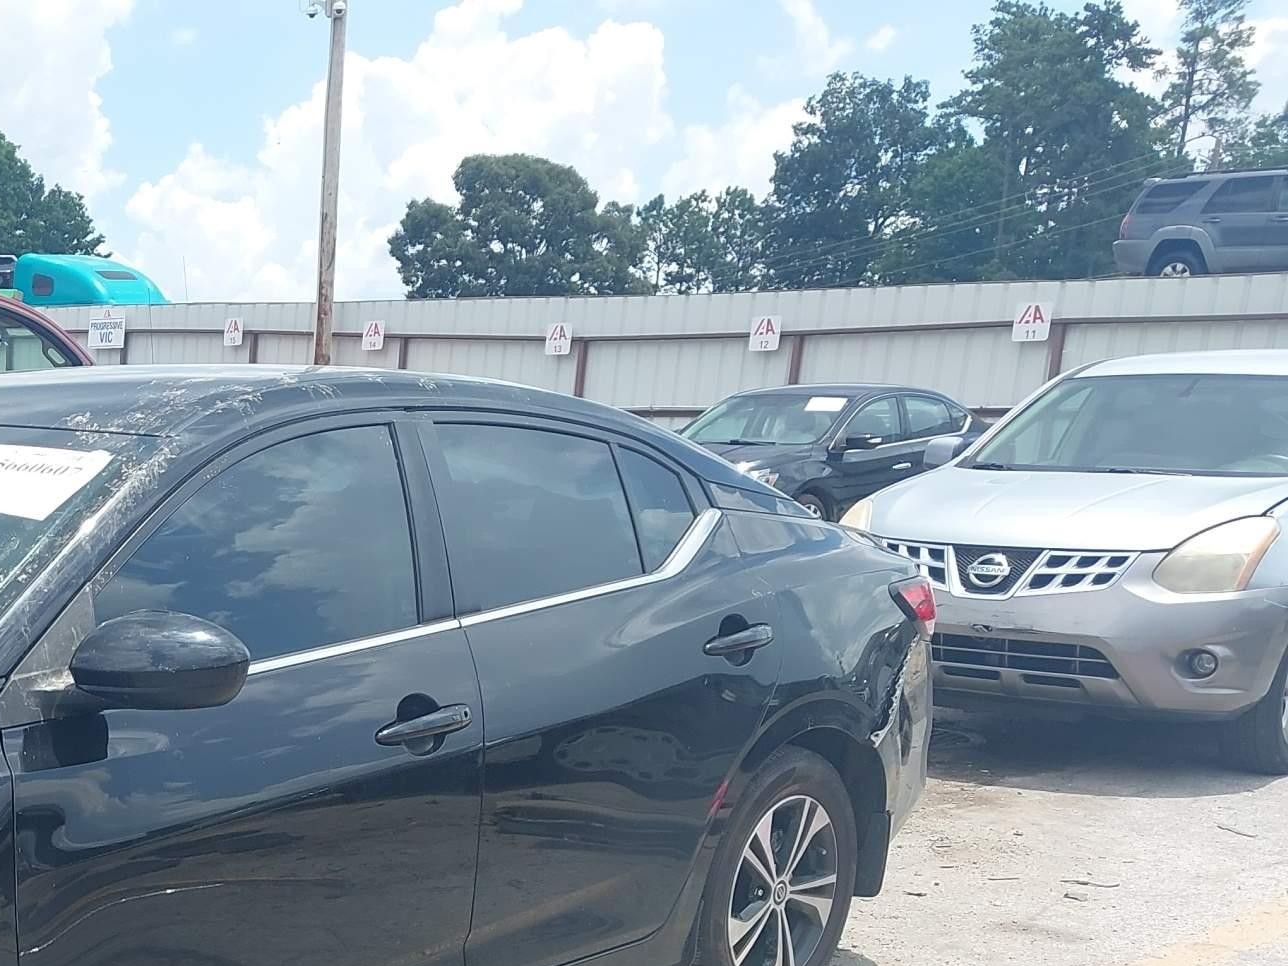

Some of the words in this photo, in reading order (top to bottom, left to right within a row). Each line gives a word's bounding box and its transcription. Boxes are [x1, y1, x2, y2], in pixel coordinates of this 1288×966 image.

[90, 321, 124, 330] PROGRESSIVE
[99, 331, 113, 344] VIC
[1024, 329, 1036, 340] 11
[369, 341, 377, 349] 14
[553, 344, 562, 353] 13
[760, 340, 769, 349] 12
[968, 565, 1007, 574] NISSAN
